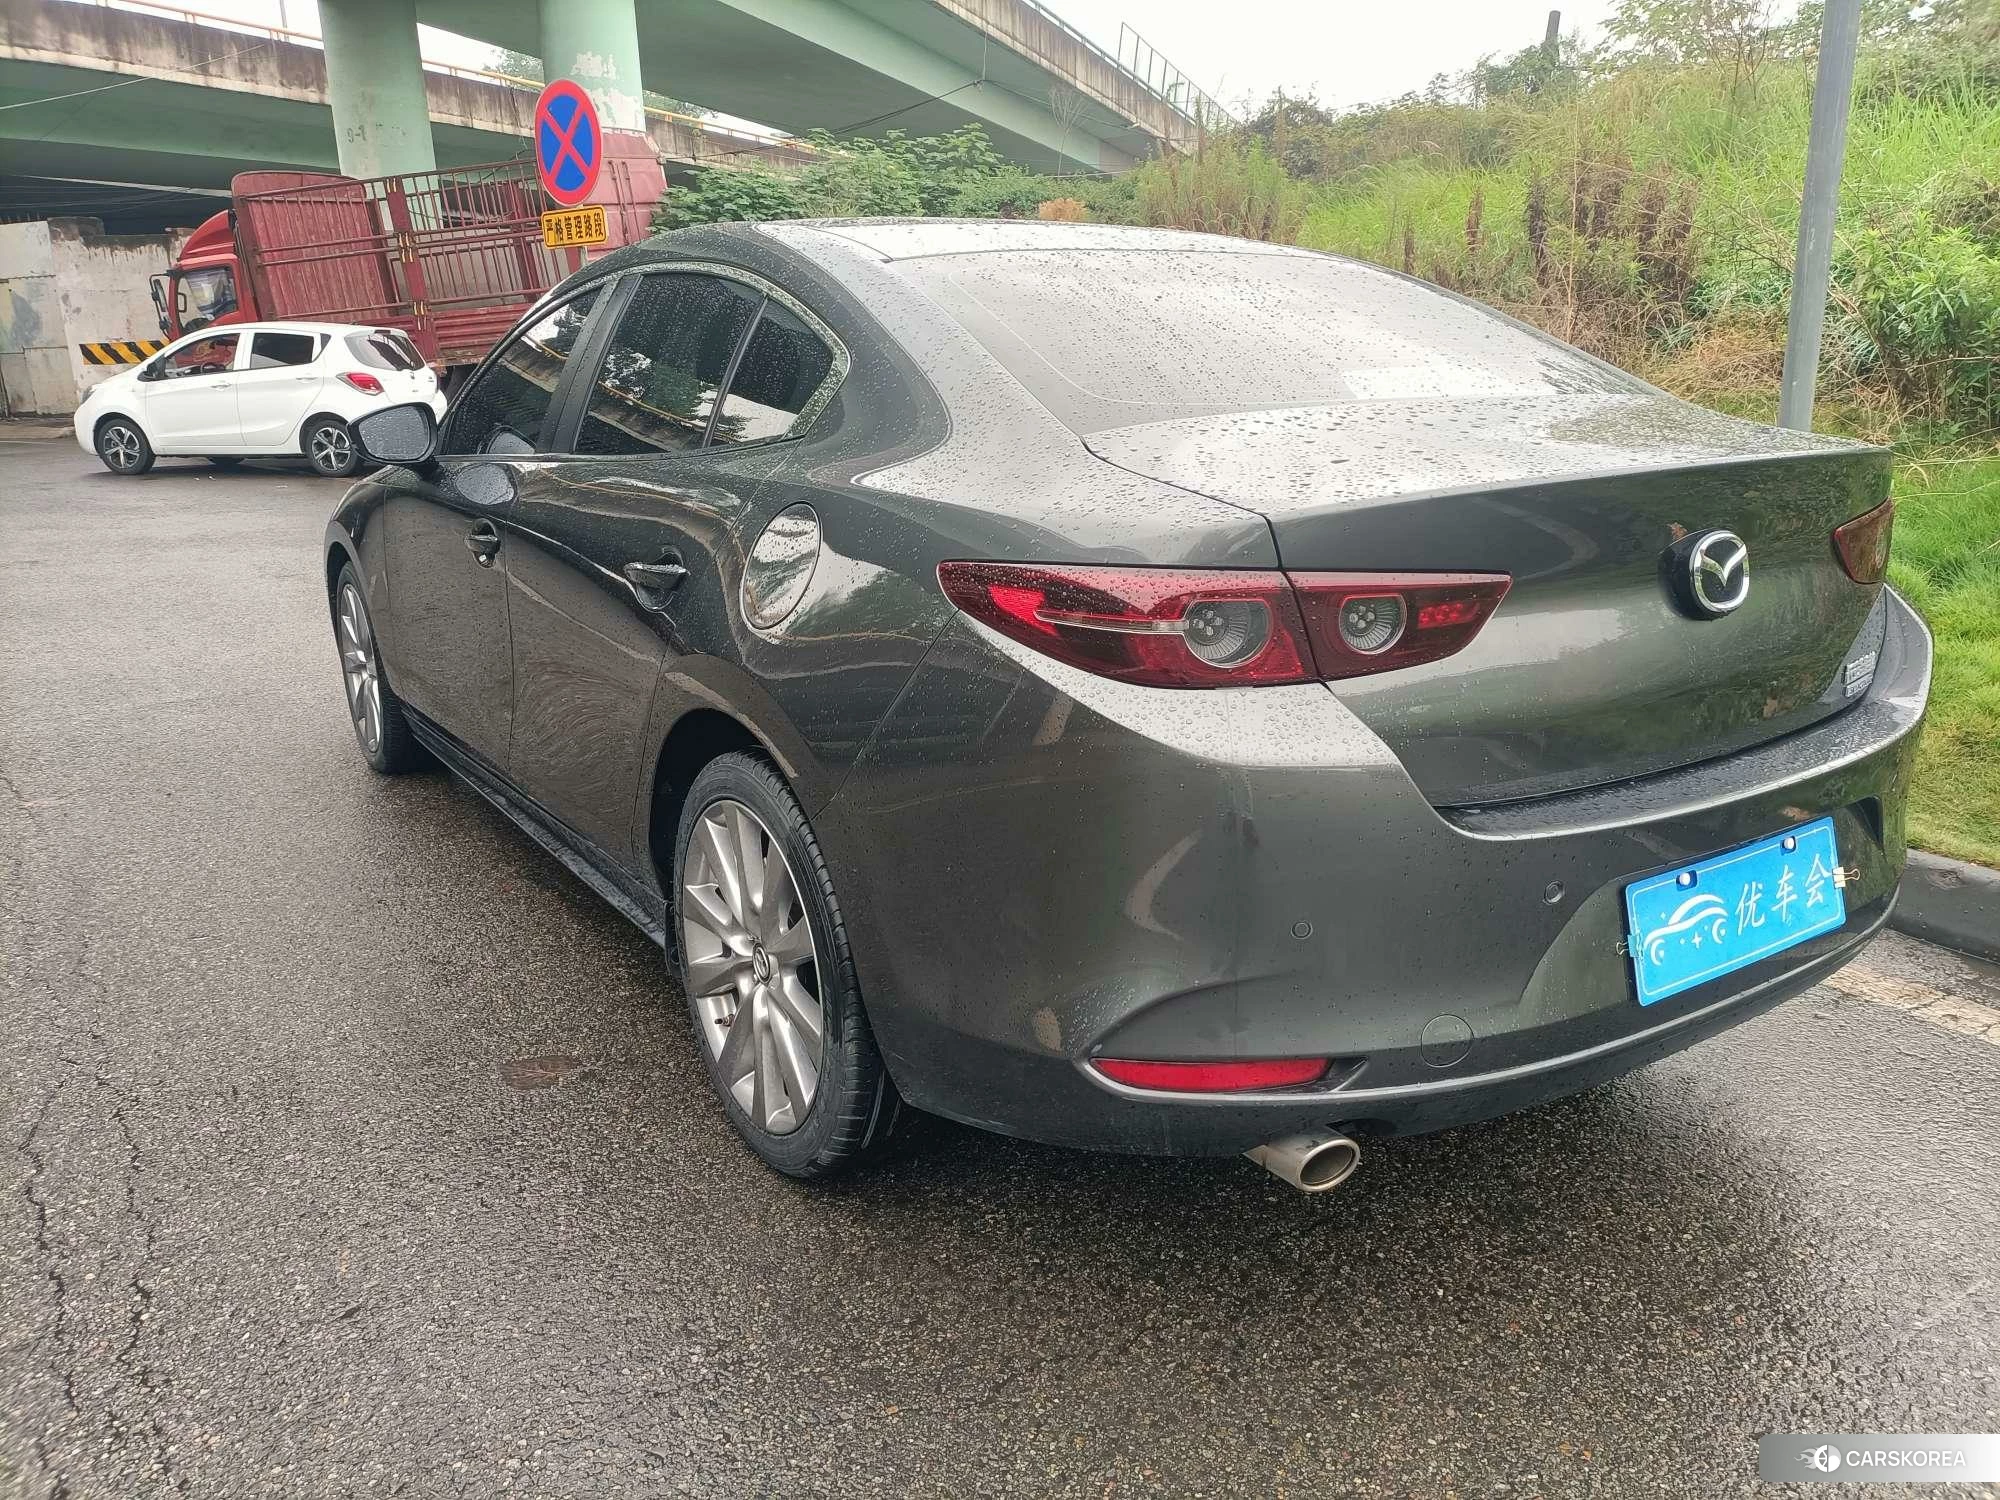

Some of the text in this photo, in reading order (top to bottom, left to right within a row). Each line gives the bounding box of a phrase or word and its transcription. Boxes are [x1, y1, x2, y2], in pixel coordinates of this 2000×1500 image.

[545, 211, 603, 242] 严格管理路段
[1735, 853, 1832, 936] 优车会
